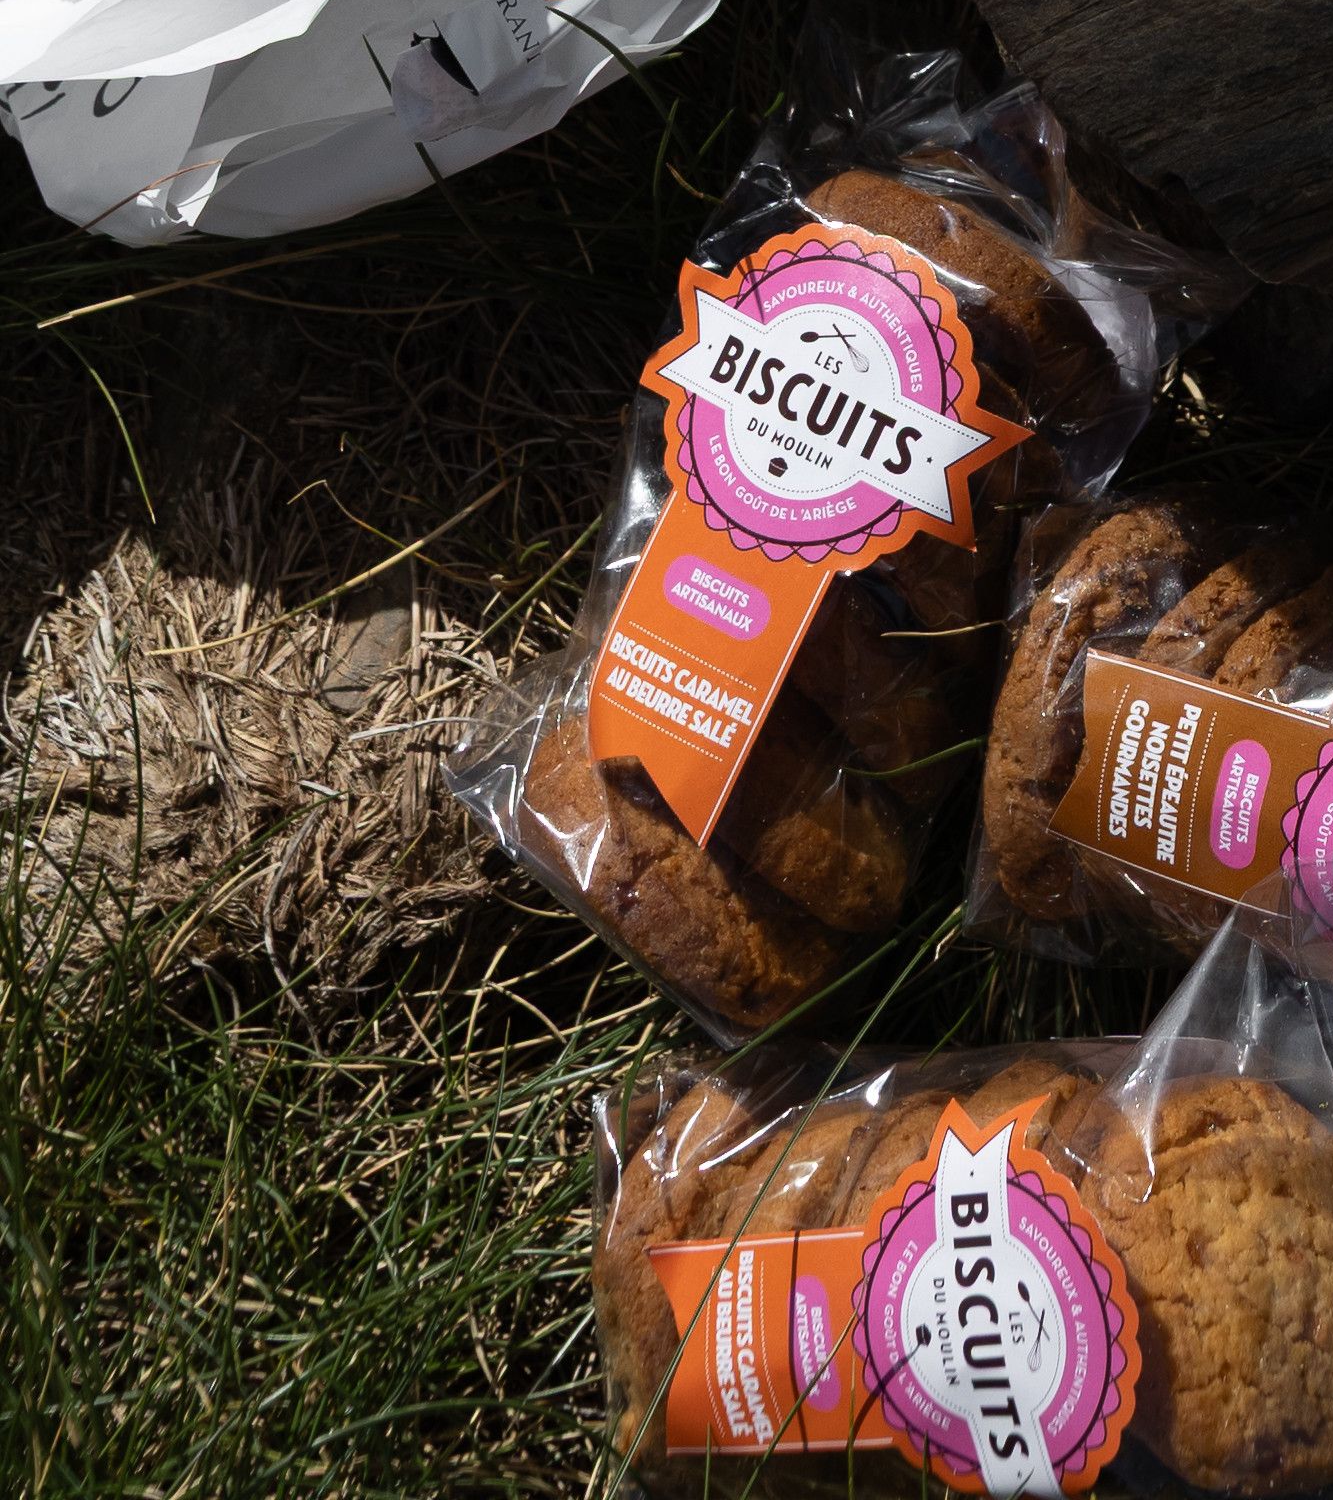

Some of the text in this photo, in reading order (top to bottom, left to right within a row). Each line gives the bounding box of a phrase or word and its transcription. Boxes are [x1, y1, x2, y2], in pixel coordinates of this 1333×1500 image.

[763, 280, 923, 393] SAVOUREUX & AUTHENTIQUES
[815, 351, 843, 375] LES
[709, 333, 922, 475] BISCUITS
[709, 435, 722, 456] LE
[747, 417, 834, 471] DU MOULIN
[713, 454, 736, 487] BON
[735, 486, 770, 516] GOÛT
[769, 499, 789, 520] DE
[671, 580, 753, 633] ARTISANAUX
[691, 567, 749, 608] BISCUITS
[605, 665, 738, 749] AU BEURRE SALÉ
[609, 631, 754, 726] BISCUITS CARAMEL
[1109, 699, 1150, 839] GOURMANDES
[1133, 720, 1171, 830] NOISETTES
[1156, 703, 1203, 865] PETIT ÉPEAUTRE
[1219, 753, 1246, 852] ARTISANAUX
[1237, 773, 1259, 843] BISCUITS
[736, 1250, 774, 1446] BISCUITS CARAMEL
[882, 1261, 910, 1347] BON GOÛT
[933, 1277, 959, 1386] DU MOULIN
[950, 1192, 1029, 1460] BISCUITS
[1009, 1311, 1024, 1345] LES
[1018, 1216, 1089, 1436] SAVOUREUX & AUTHENTIQUES
[716, 1269, 753, 1438] AU BEURRE SALÉ
